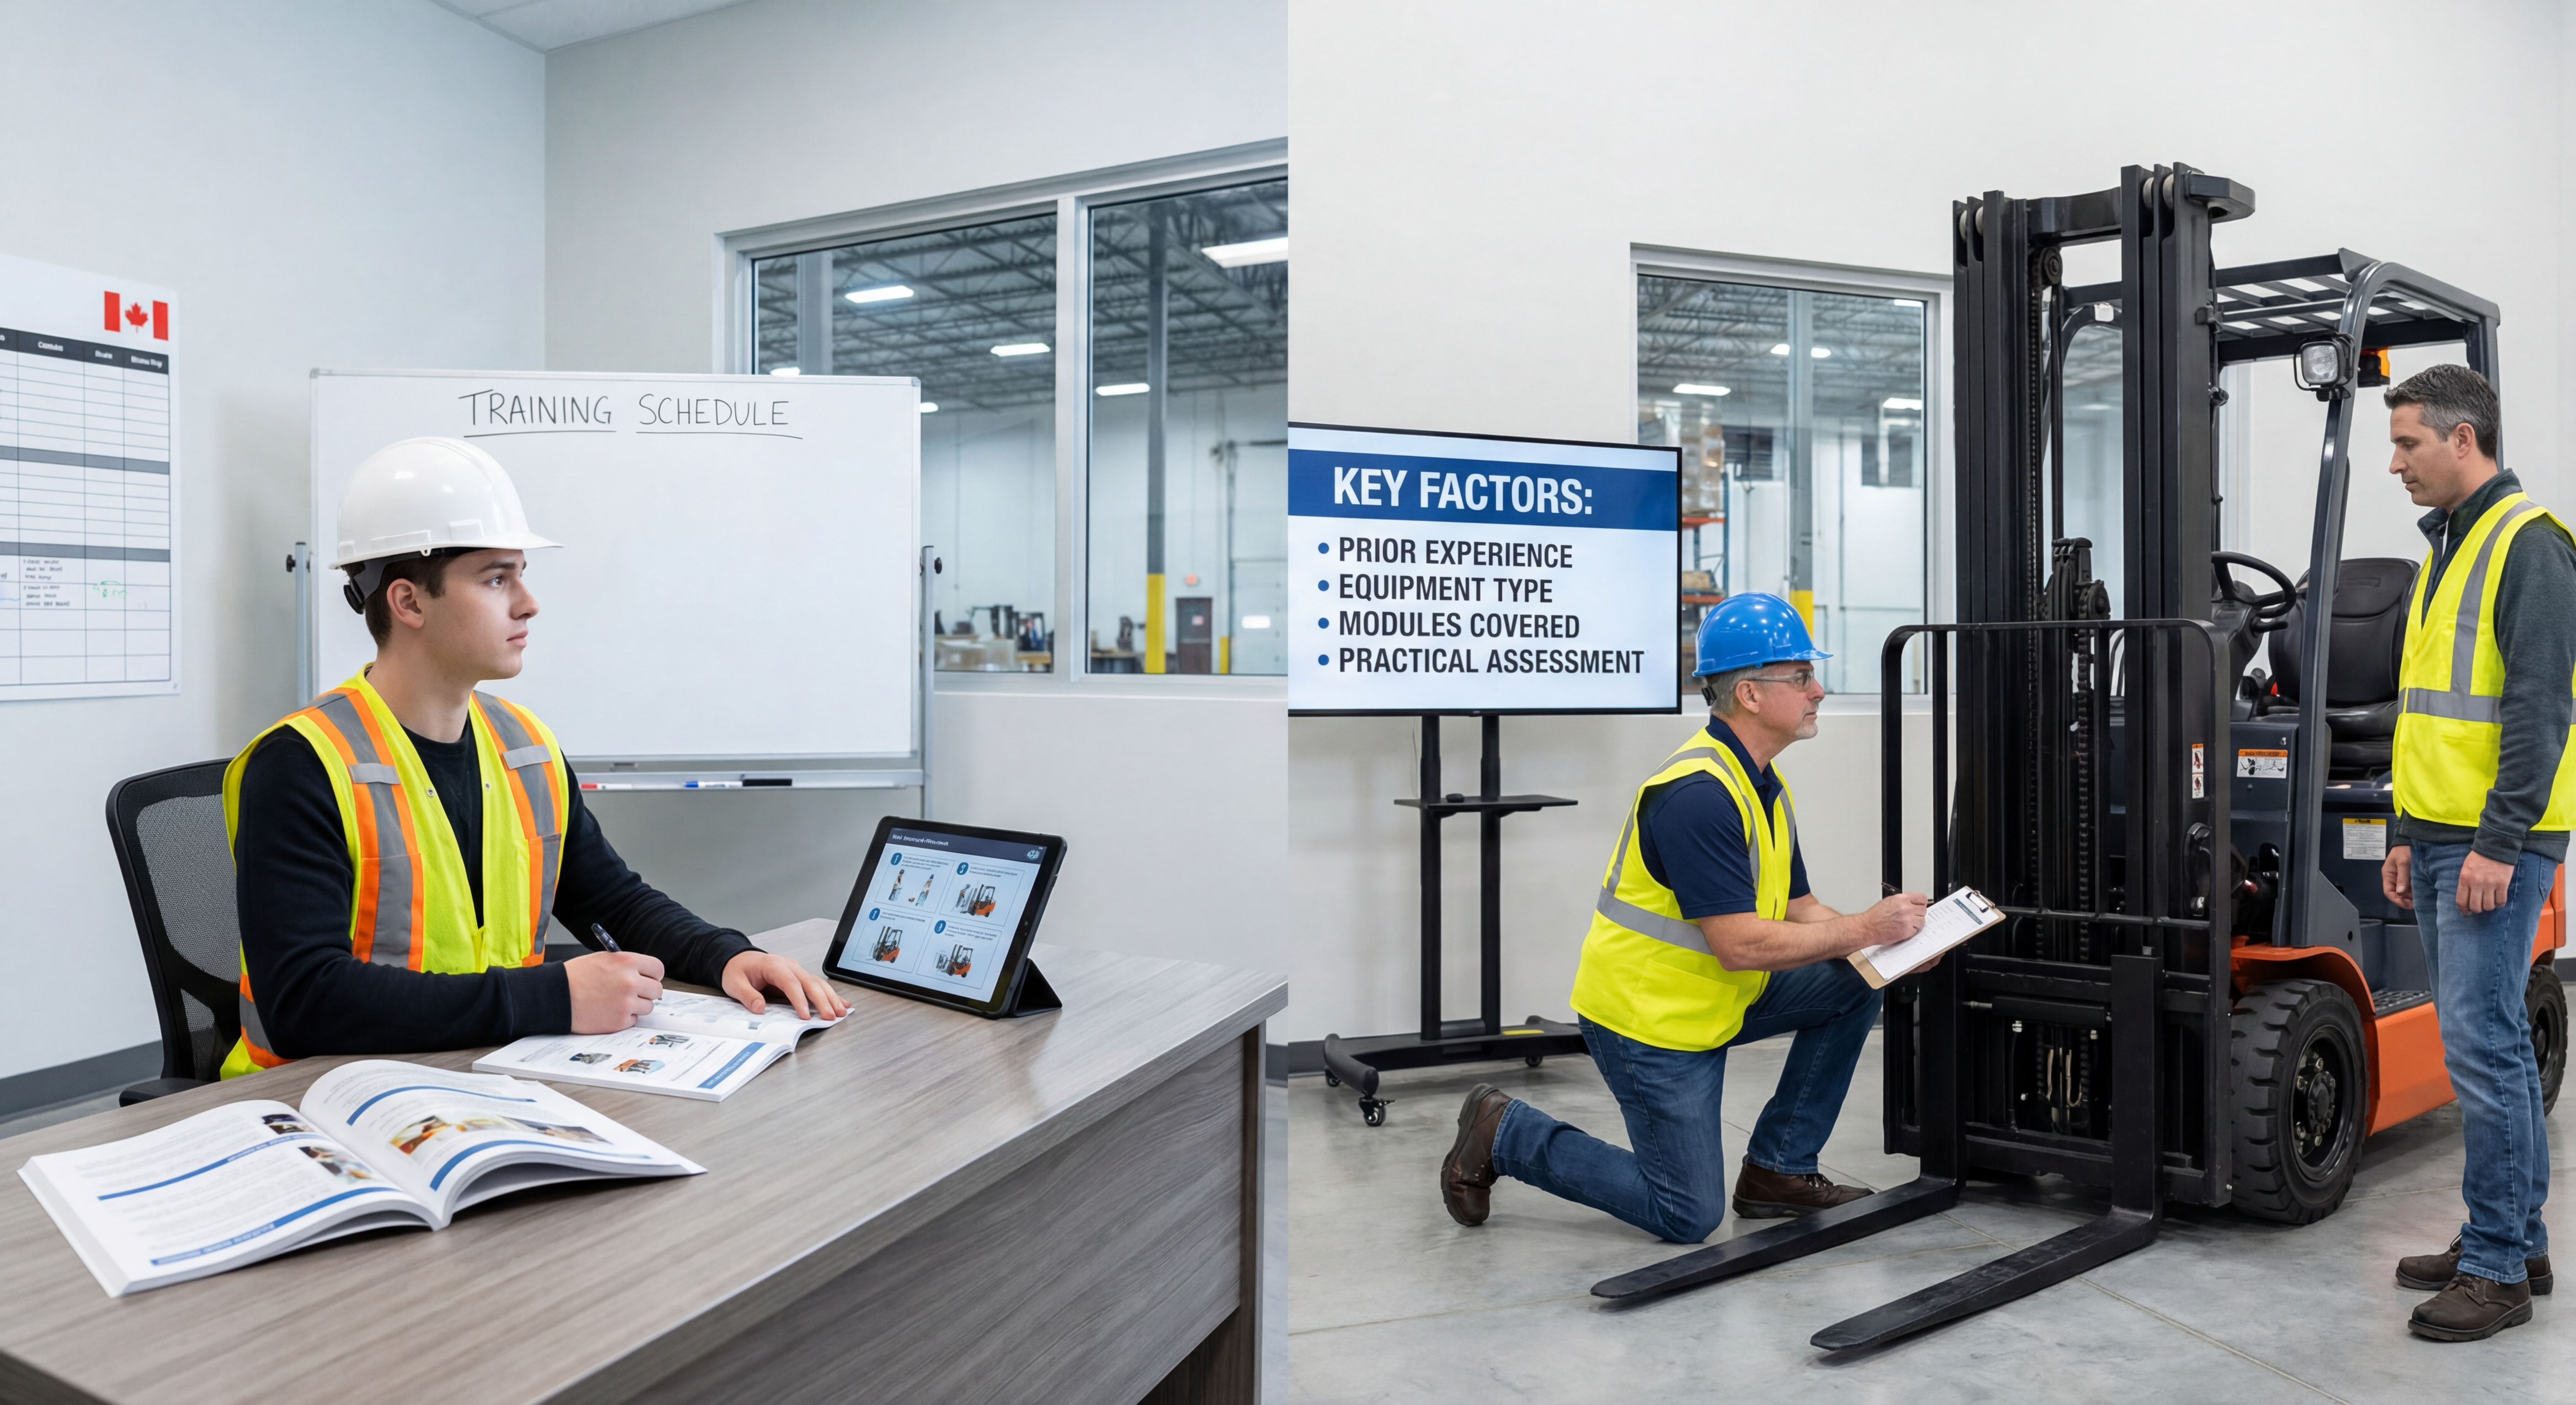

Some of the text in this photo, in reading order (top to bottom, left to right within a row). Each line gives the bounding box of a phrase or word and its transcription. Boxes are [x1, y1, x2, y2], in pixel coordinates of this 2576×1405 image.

[458, 389, 789, 426] TRAINING SCHEDULE
[1335, 467, 1592, 515] KEY FACTORS:
[1340, 537, 1572, 568] PRIOR EXPERIENCE
[1340, 574, 1552, 603] EQUIPMENT TYPE
[1340, 611, 1579, 638] MODULES COVERED
[1340, 648, 1644, 673] PRACTICAL ASSESSMENT
